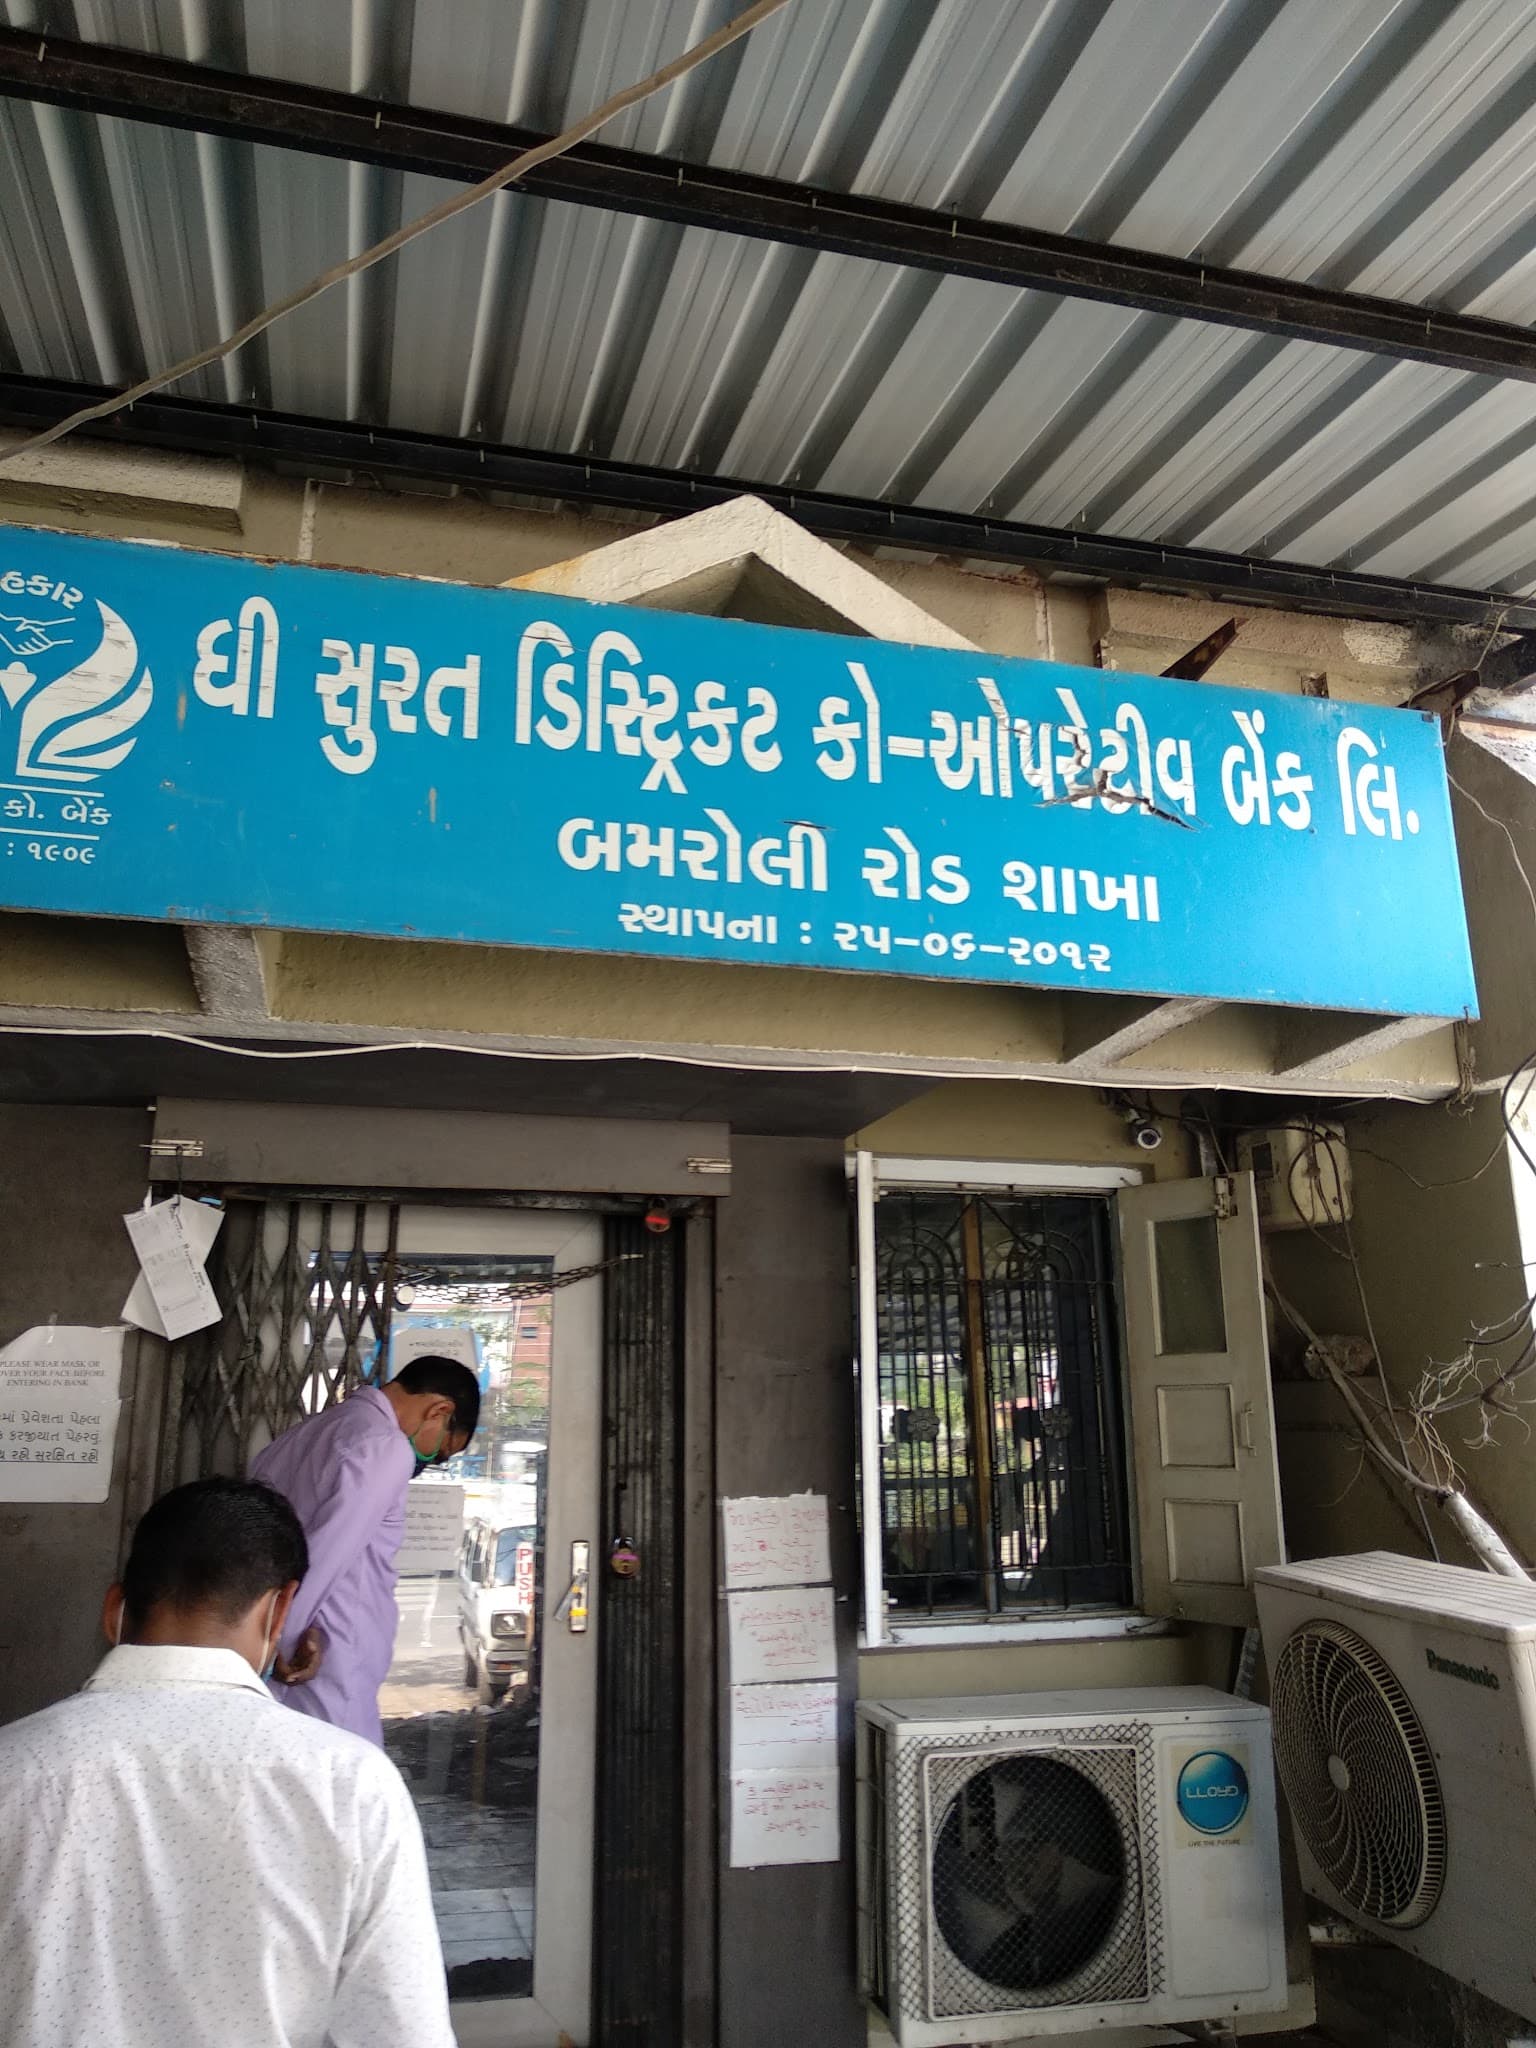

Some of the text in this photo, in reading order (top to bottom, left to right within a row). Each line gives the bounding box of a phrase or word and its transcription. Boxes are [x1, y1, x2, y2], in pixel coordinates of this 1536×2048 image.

[0, 571, 84, 610] હકાર
[315, 638, 481, 775] સુરત
[1221, 709, 1315, 831] બેંક
[1336, 726, 1421, 842] લિ.
[3, 791, 112, 826] કો. બેંક
[27, 842, 96, 865] ૧૯૦૯
[556, 808, 1161, 923] બમરોલી રોડ શાખા
[618, 903, 778, 945] સ્થાપના
[832, 921, 1112, 974] ૨૫-૦૬-૨૦૧૨
[518, 1548, 534, 1605] PUSH
[1425, 1647, 1500, 1691] Panasonic
[1185, 1785, 1239, 1799] LLOYD
